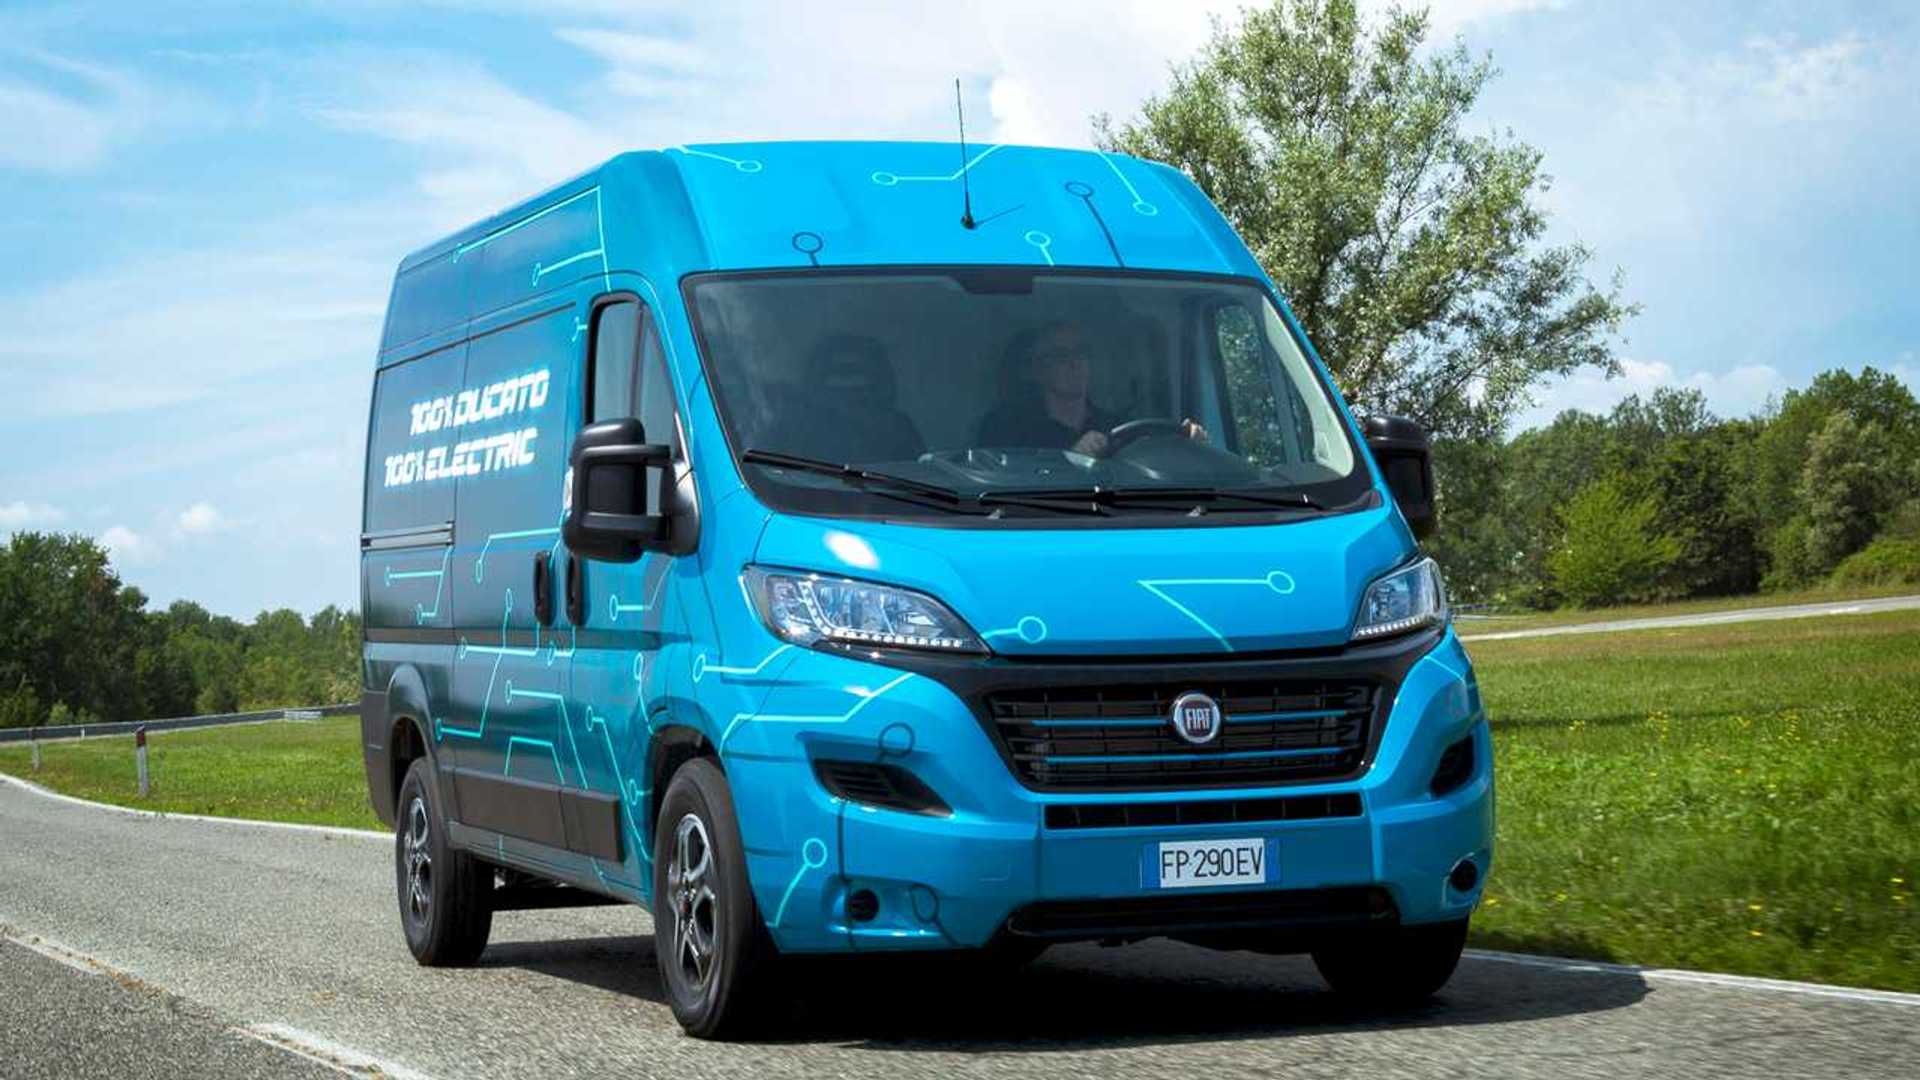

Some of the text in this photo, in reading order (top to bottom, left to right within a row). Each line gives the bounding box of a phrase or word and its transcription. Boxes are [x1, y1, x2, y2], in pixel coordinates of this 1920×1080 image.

[453, 369, 550, 427] DUCATO
[424, 427, 538, 482] ELECTRIC
[1185, 707, 1210, 731] FIAT
